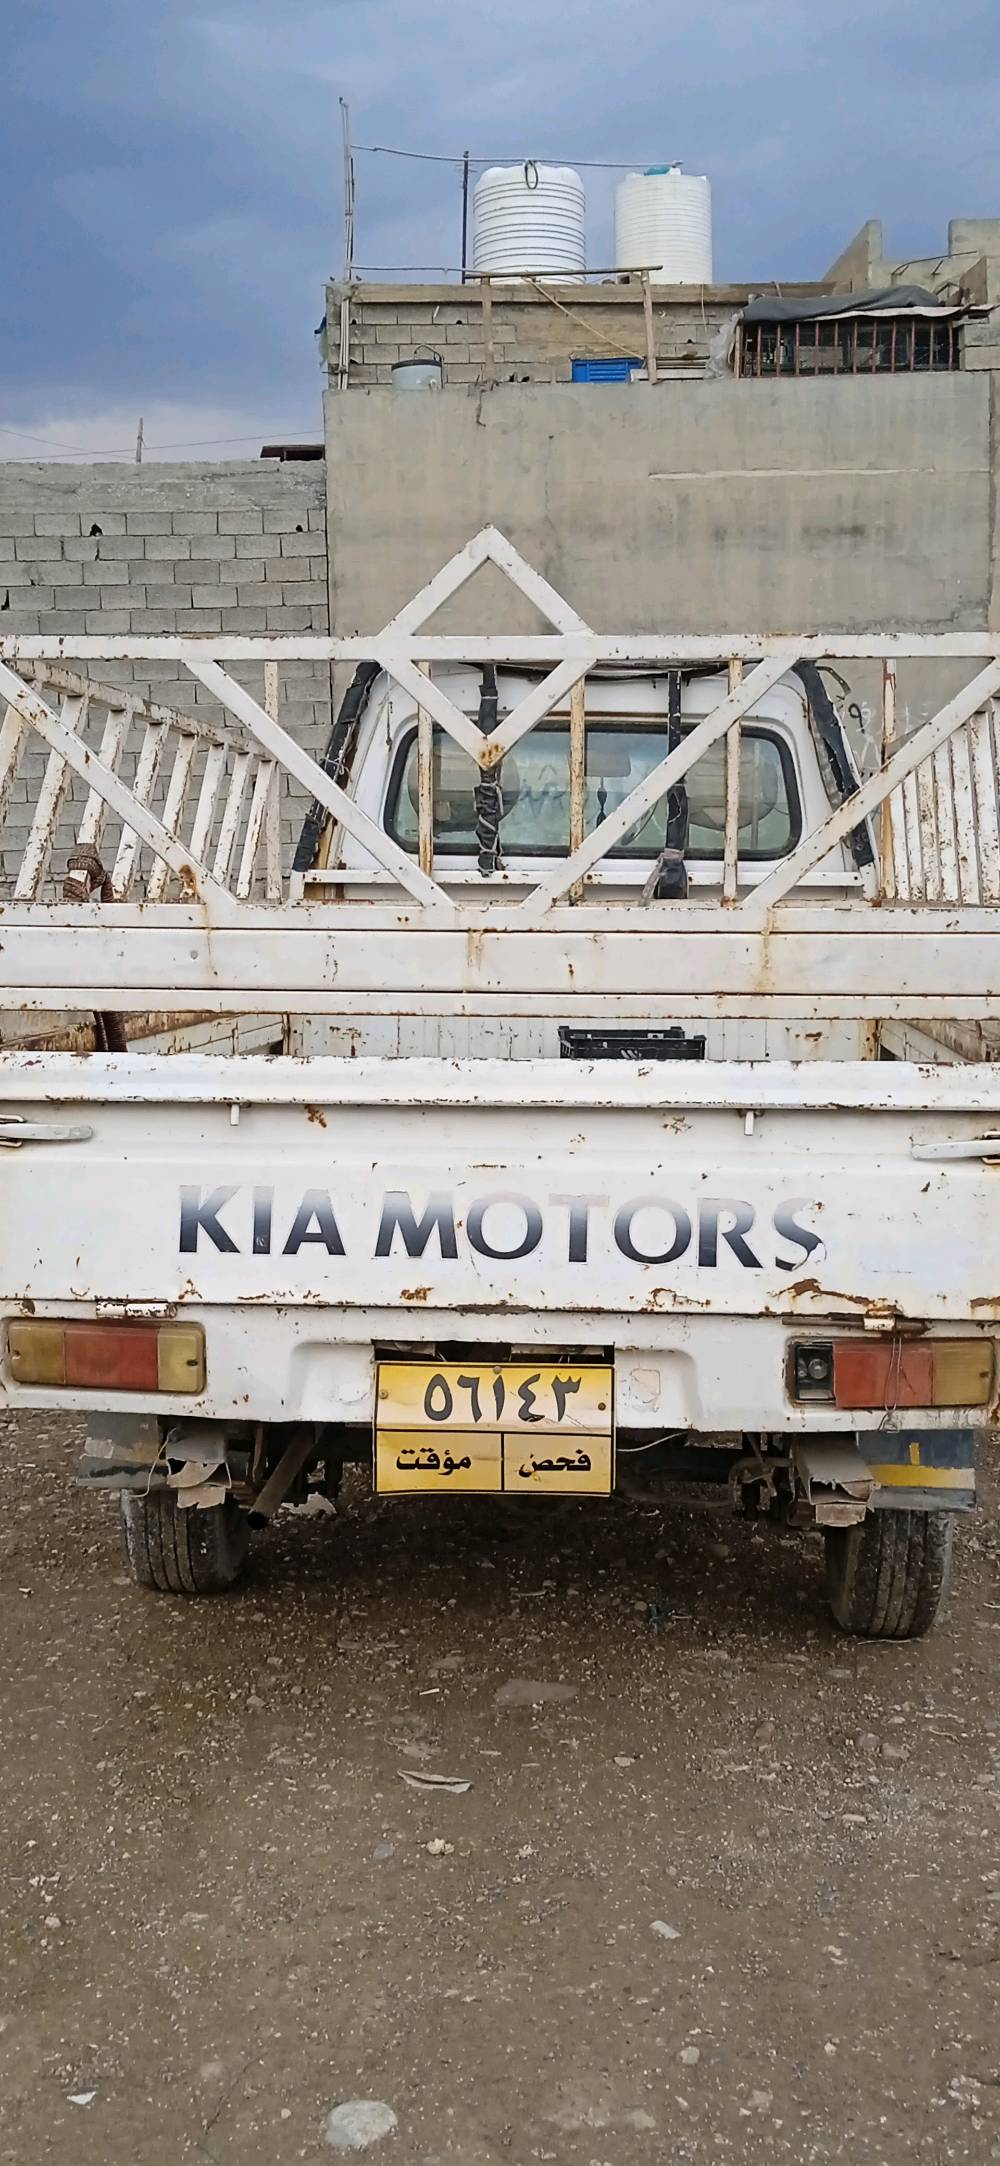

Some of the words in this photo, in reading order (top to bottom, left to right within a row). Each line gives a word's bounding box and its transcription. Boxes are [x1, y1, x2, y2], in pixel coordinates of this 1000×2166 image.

[178, 1185, 346, 1256] KIA
[373, 1190, 828, 1272] MOTORS
[423, 1372, 583, 1423] ٥٦١٤٣
[396, 1447, 472, 1476] مؤقت
